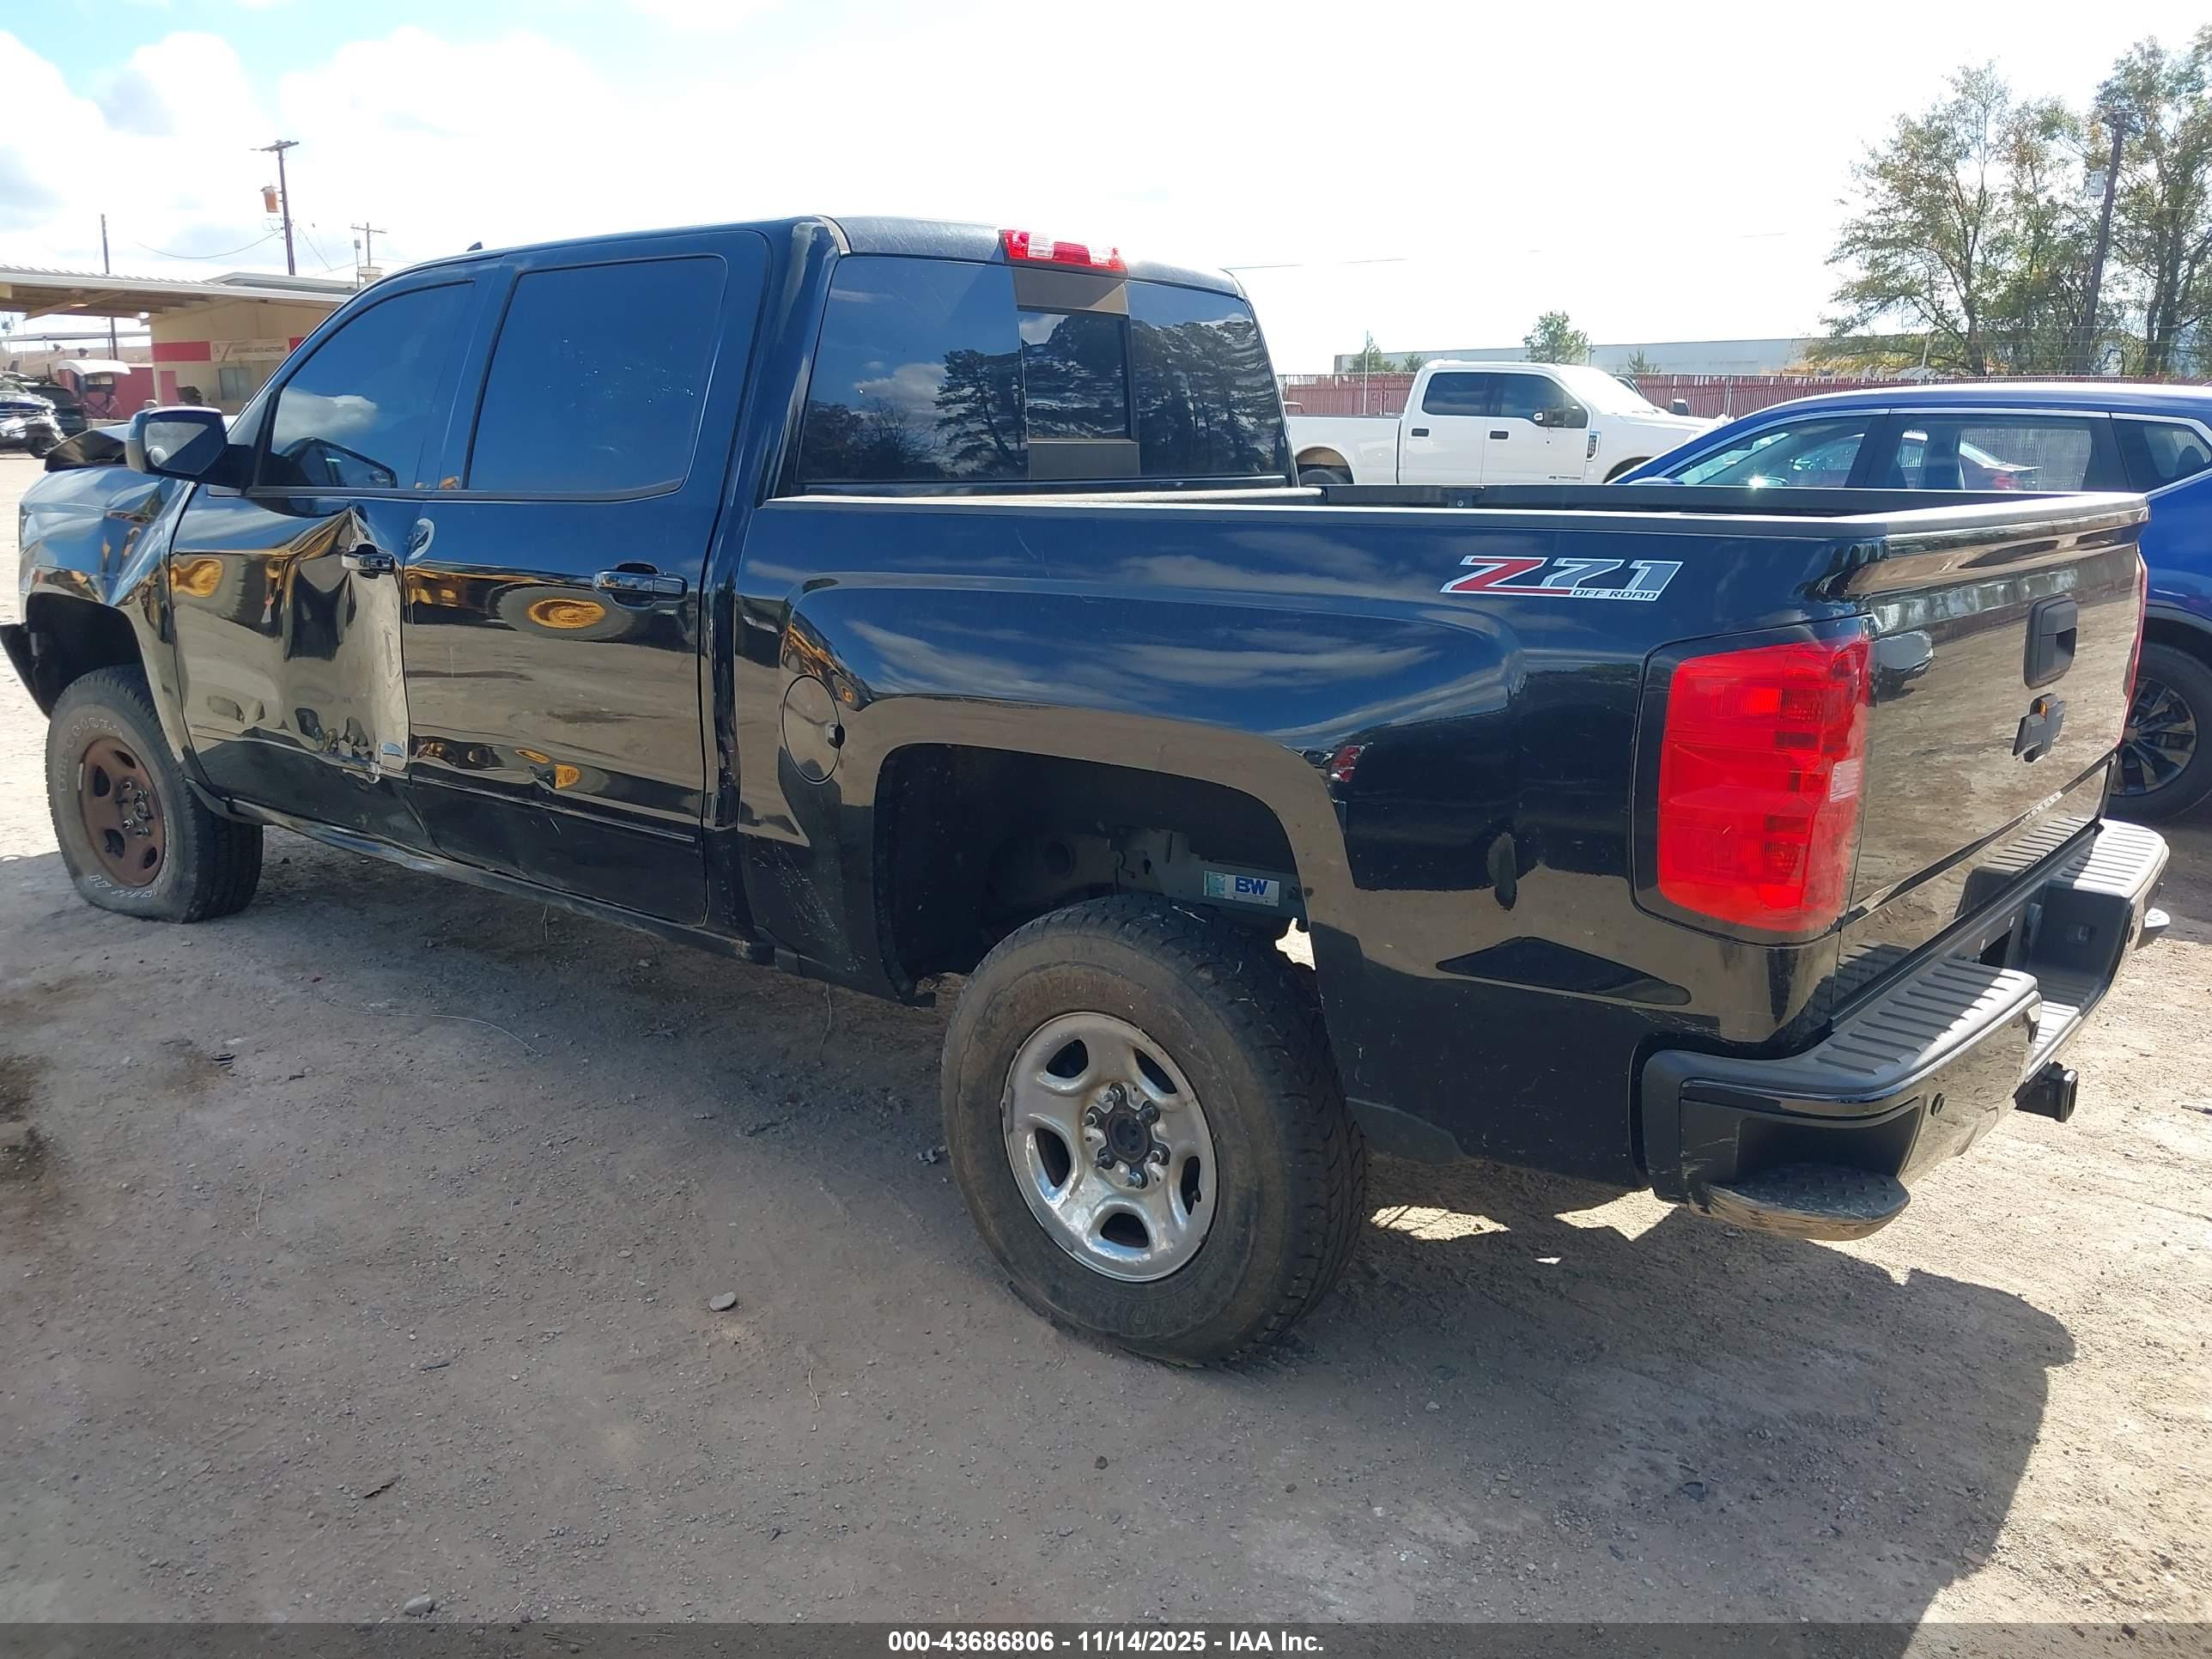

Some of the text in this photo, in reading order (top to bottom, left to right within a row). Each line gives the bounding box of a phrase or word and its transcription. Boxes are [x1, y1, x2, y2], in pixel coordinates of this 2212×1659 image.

[1440, 556, 1683, 598] Z71
[1573, 589, 1657, 599] OFF ROAD
